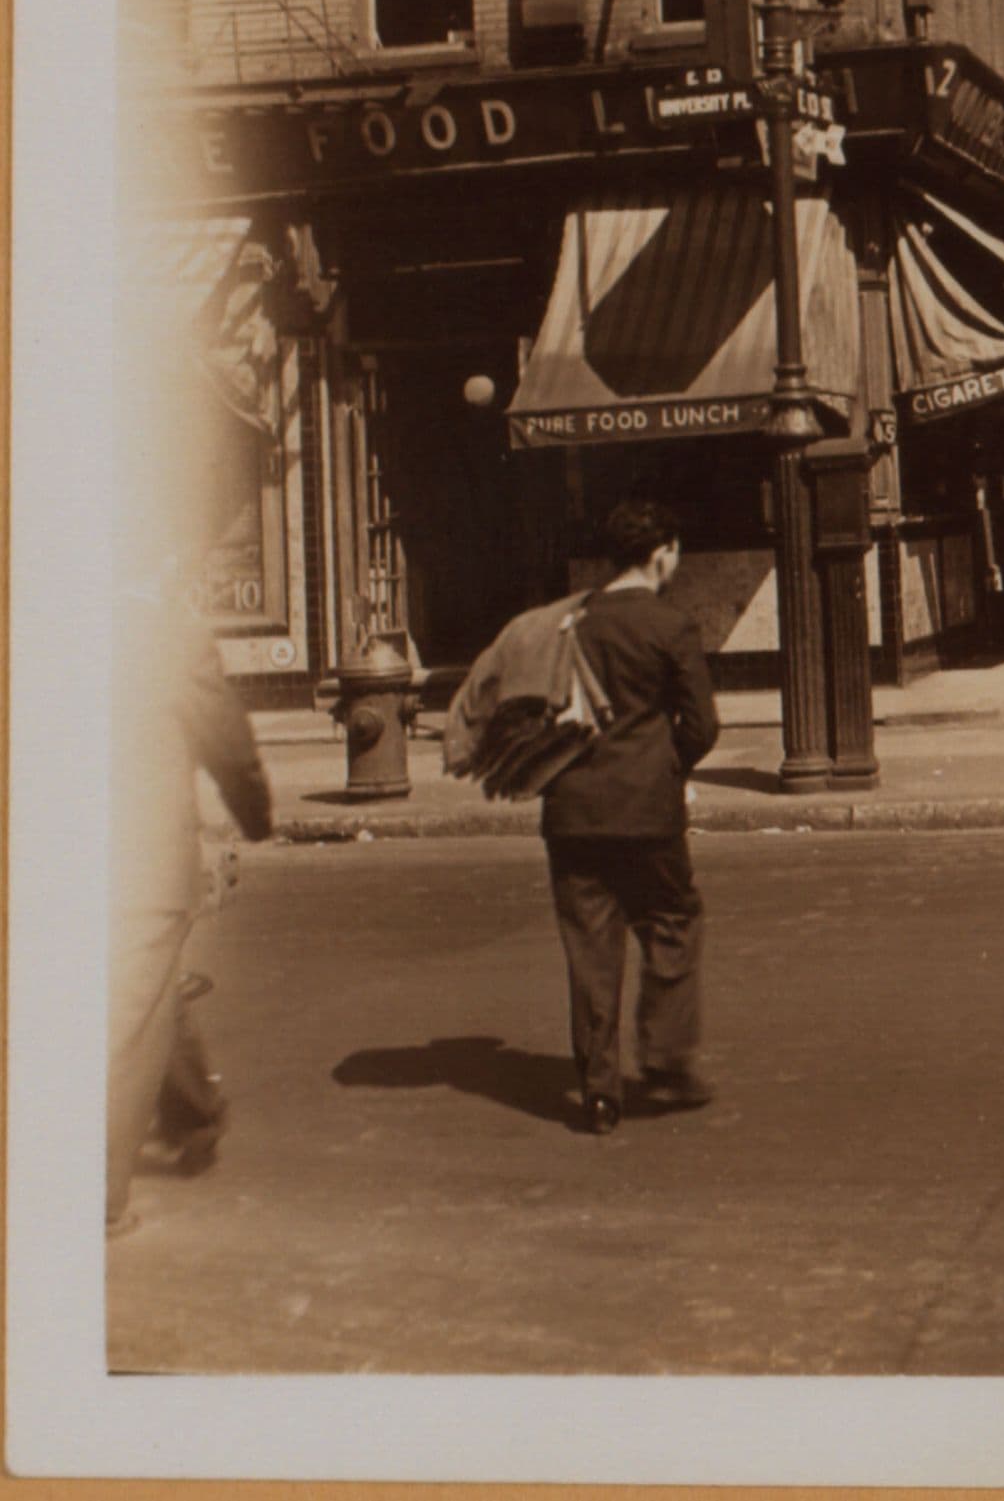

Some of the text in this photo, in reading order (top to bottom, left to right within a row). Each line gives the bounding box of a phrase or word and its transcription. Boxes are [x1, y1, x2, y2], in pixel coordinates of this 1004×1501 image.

[658, 92, 731, 117] UNIVERSITY
[305, 99, 517, 163] FOOD
[526, 403, 741, 438] PURE FOOD LUNCH
